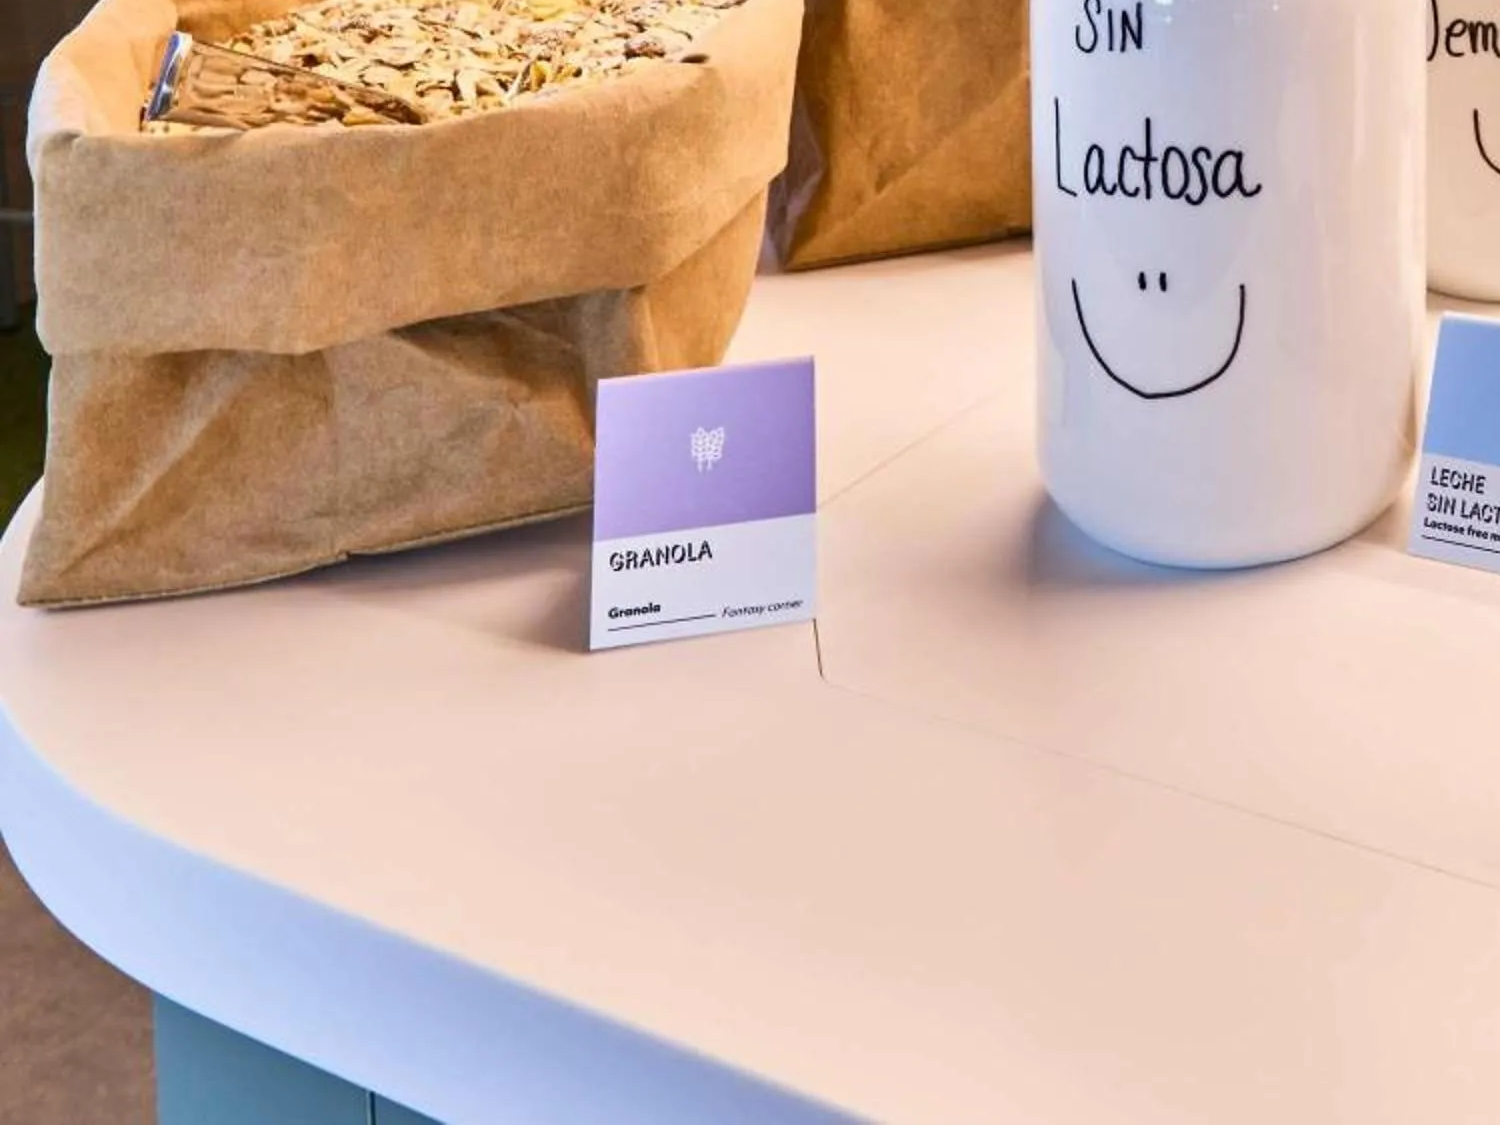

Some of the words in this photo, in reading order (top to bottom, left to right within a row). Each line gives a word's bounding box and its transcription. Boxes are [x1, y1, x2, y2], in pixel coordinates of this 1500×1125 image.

[1054, 97, 1262, 205] Lactosa
[1430, 466, 1486, 493] LECHE
[1426, 492, 1456, 515] SIN
[1423, 517, 1465, 535] Lactose
[1466, 524, 1488, 539] free
[608, 539, 713, 571] GRANOLA
[607, 601, 661, 618] Granola
